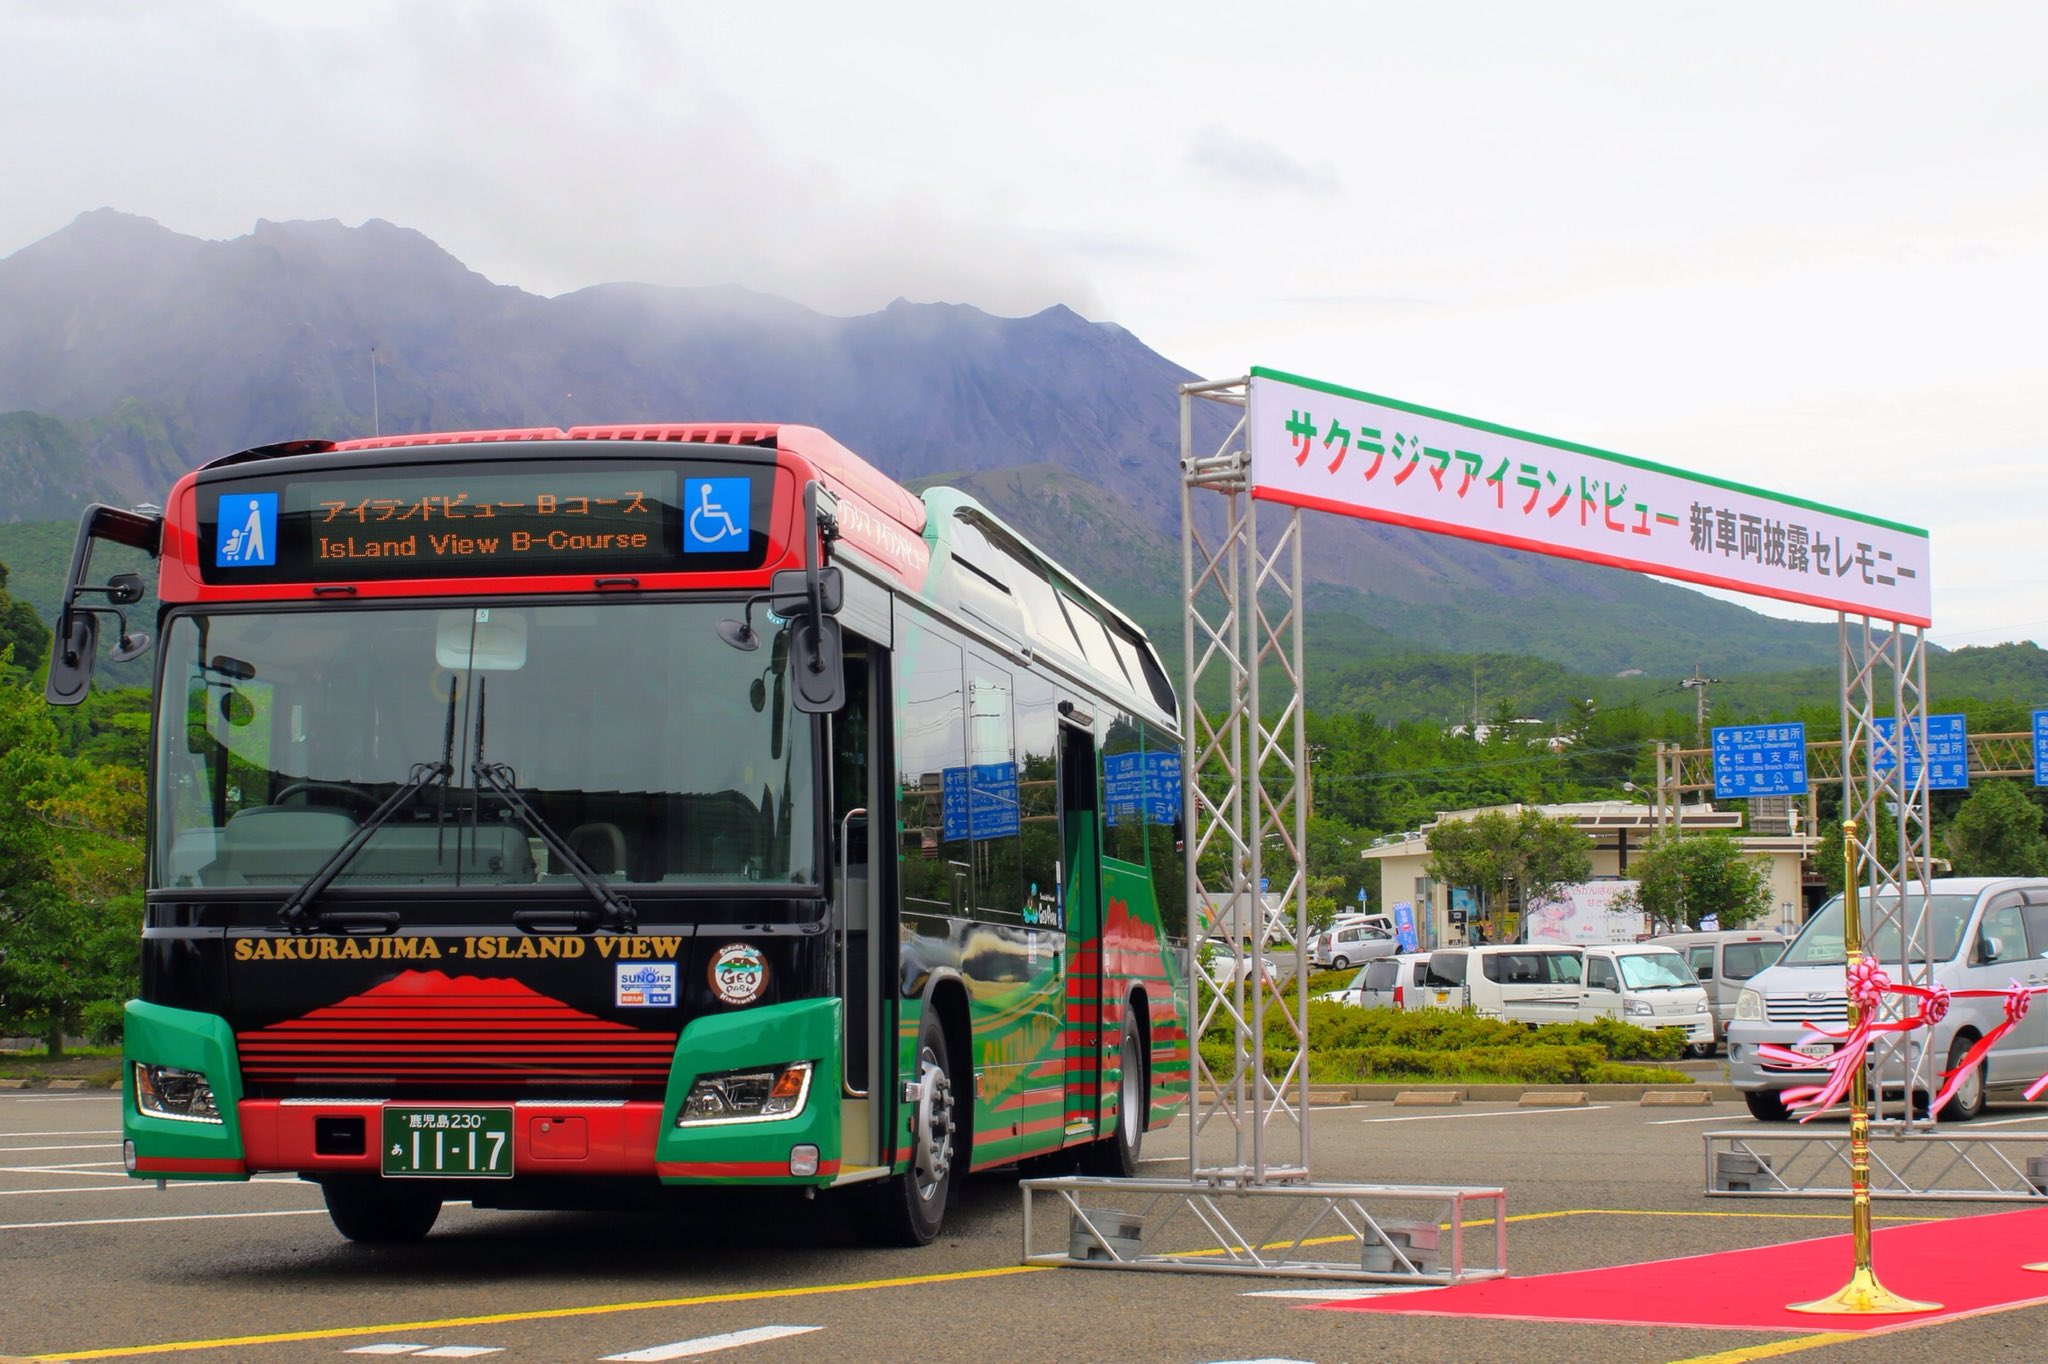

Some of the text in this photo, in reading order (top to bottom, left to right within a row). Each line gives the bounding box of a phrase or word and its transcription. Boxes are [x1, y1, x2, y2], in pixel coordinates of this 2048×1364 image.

[1284, 408, 1916, 587] サクラジマアイランドビュー 新車両披露セレモニー
[428, 533, 499, 556] View
[511, 530, 648, 552] B-Course
[234, 937, 442, 961] SAKURAJIMA
[464, 936, 586, 960] ISLAND
[594, 936, 683, 959] VIEW
[720, 968, 757, 985] GEO
[391, 1131, 506, 1170] あ 11-17
